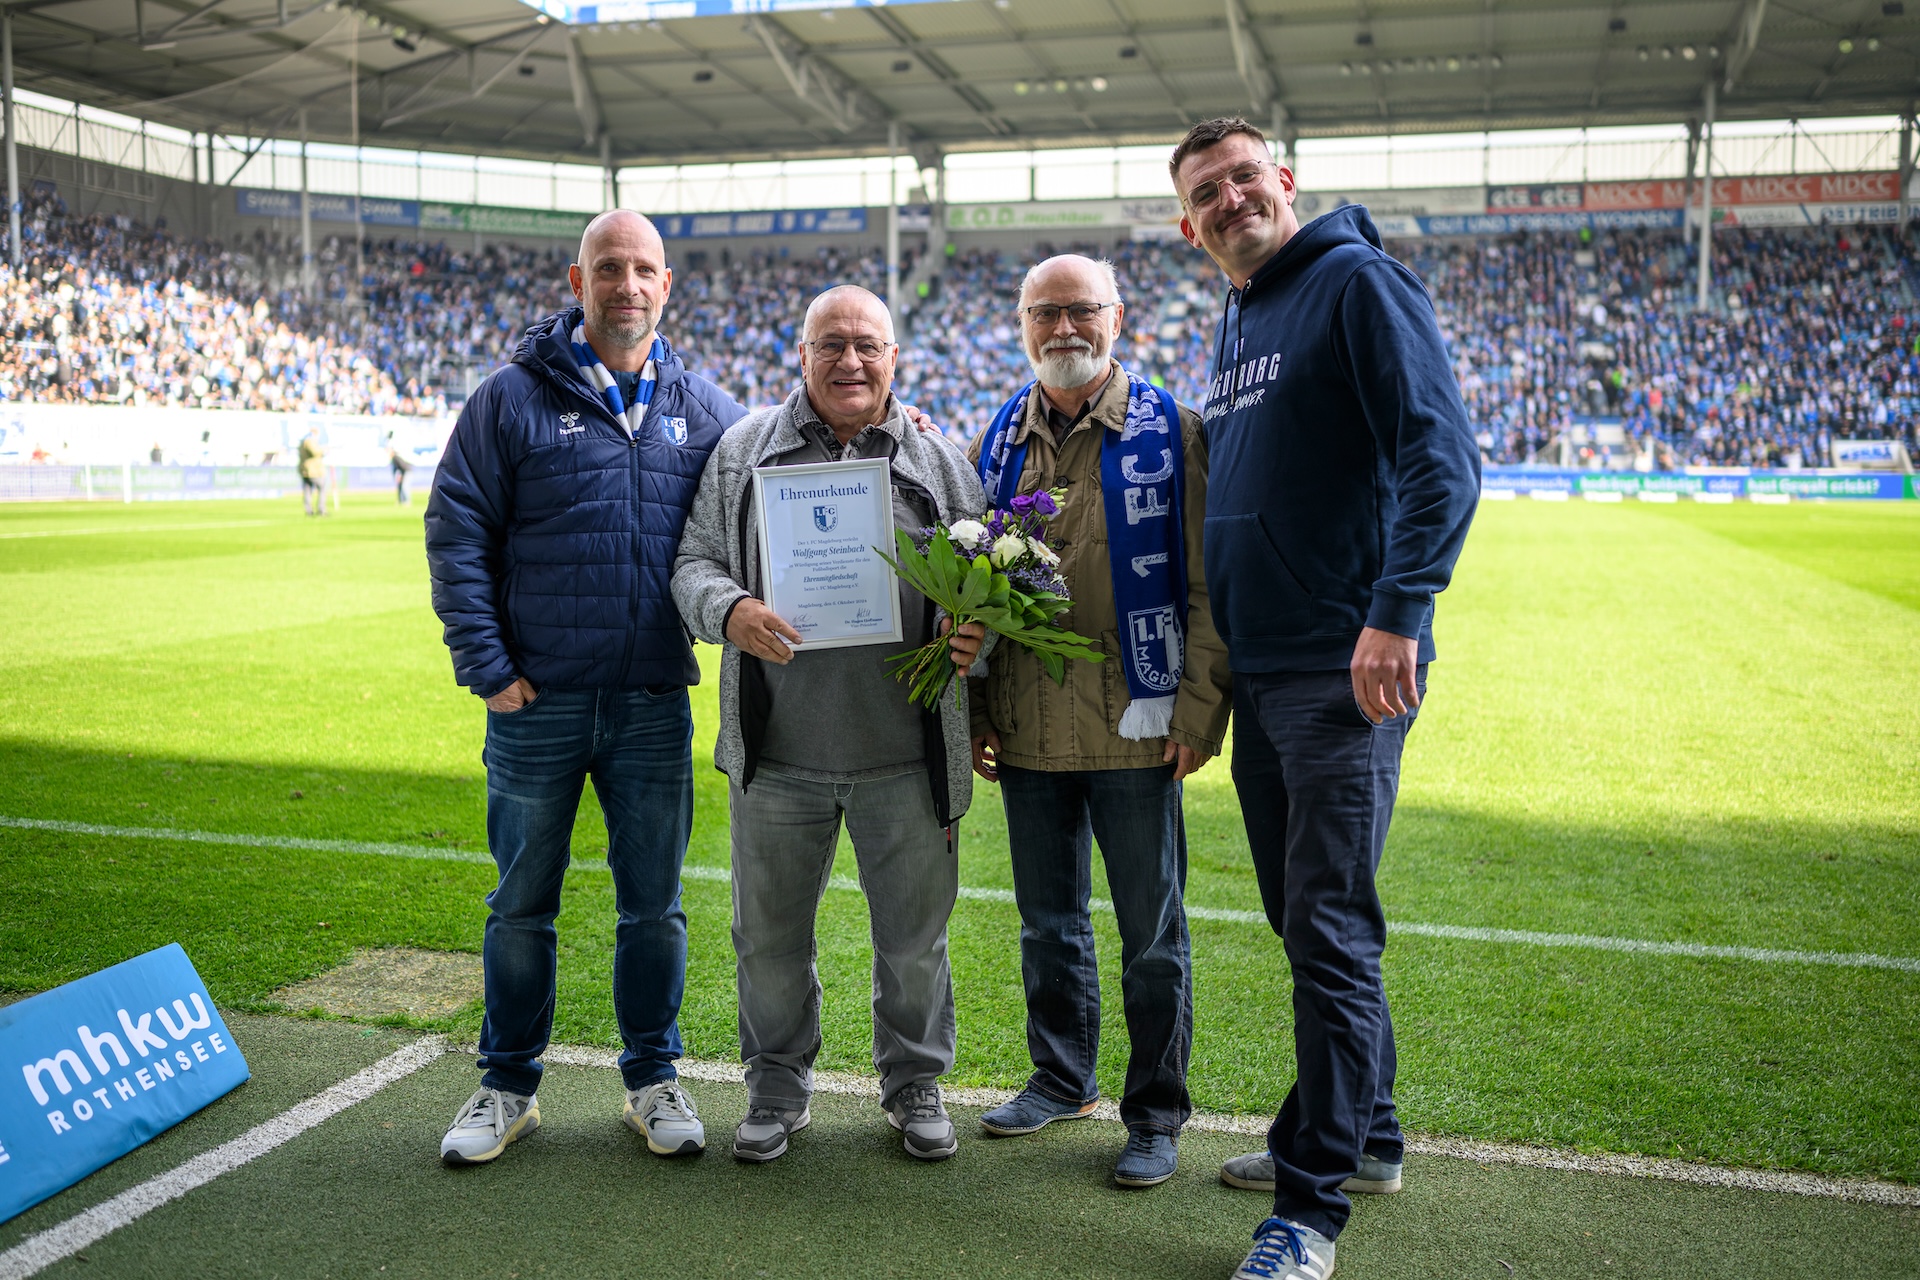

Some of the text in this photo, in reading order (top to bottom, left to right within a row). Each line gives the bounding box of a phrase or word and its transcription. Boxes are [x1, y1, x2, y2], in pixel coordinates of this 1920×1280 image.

[1585, 183, 1654, 204] MDCC
[1741, 177, 1811, 198] MDCC
[1821, 174, 1893, 196] MDCC
[780, 482, 868, 501] Ehrenurkunde
[1709, 478, 1739, 492] oder
[1748, 477, 1777, 492] hast
[1780, 478, 1828, 494] Gewalt
[1830, 478, 1880, 493] erlebt?
[792, 544, 865, 559] Wolfgang Steinbach
[803, 572, 858, 583] Ehrenmitgliedschaft
[22, 992, 211, 1107] mhkw
[46, 1032, 227, 1135] ROTHENSEE
